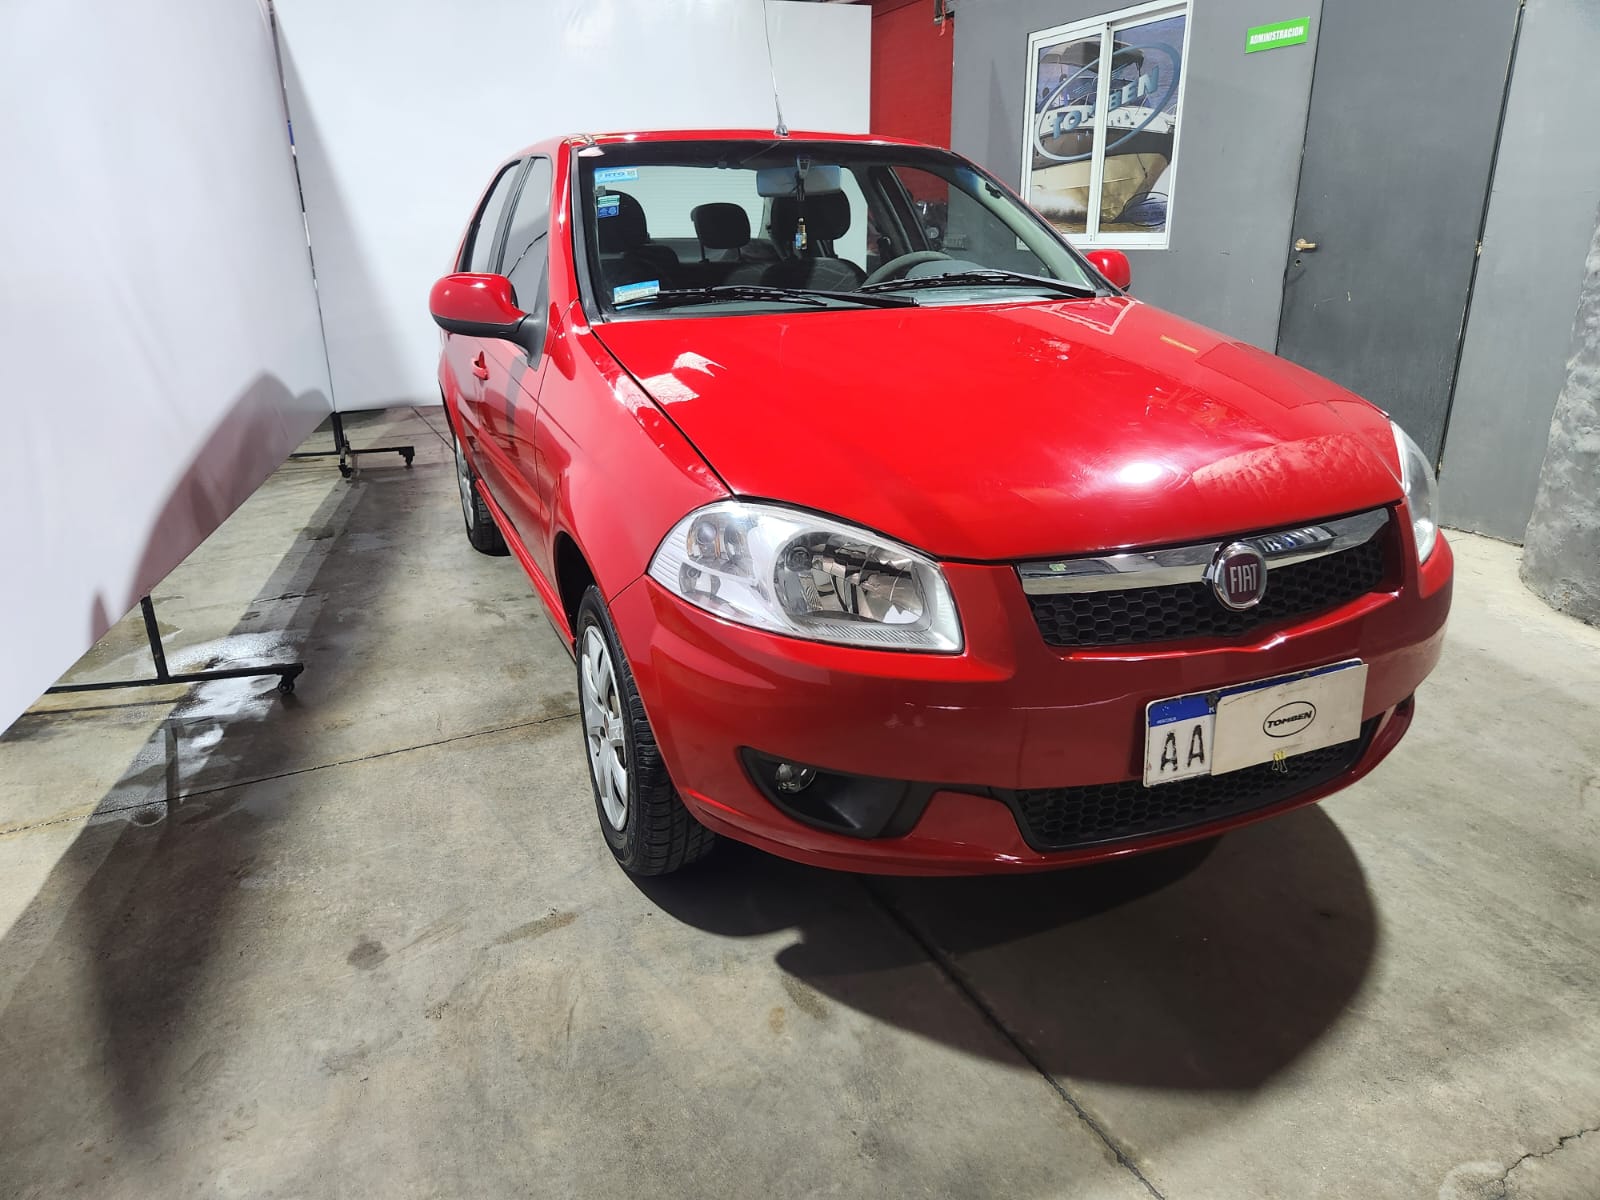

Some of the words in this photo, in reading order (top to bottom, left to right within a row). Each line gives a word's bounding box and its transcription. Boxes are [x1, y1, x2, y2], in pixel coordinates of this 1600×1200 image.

[1229, 563, 1258, 594] FIAT
[1267, 710, 1313, 729] TOMBEN
[1160, 724, 1206, 773] AA
